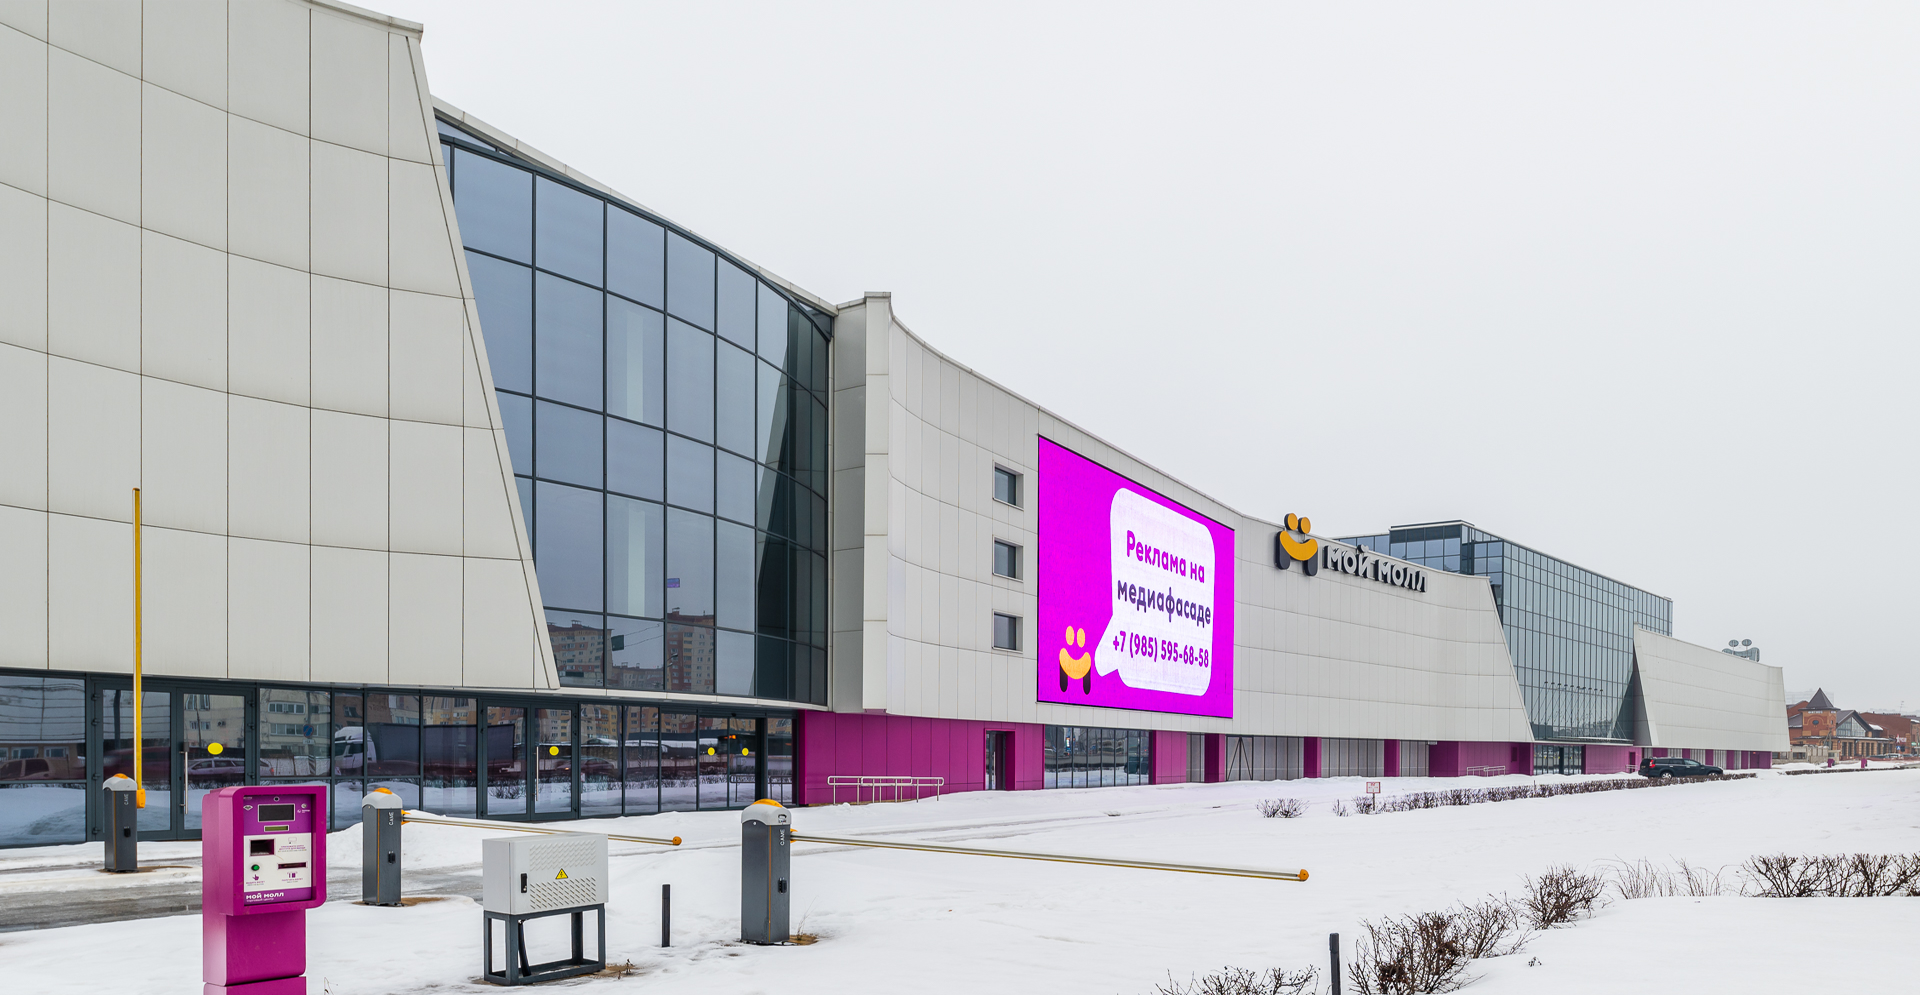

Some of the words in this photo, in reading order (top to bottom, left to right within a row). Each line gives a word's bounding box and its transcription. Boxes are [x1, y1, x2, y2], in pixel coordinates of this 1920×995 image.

[1127, 530, 1186, 577] Реклама
[1190, 561, 1205, 583] на
[1323, 544, 1371, 579] МОЙ
[1375, 559, 1428, 592] МОЛЛ
[1117, 580, 1211, 628] медиафасаде
[1113, 630, 1126, 652] +7
[1129, 632, 1157, 662] (985)
[1161, 639, 1209, 668] 595-68-58
